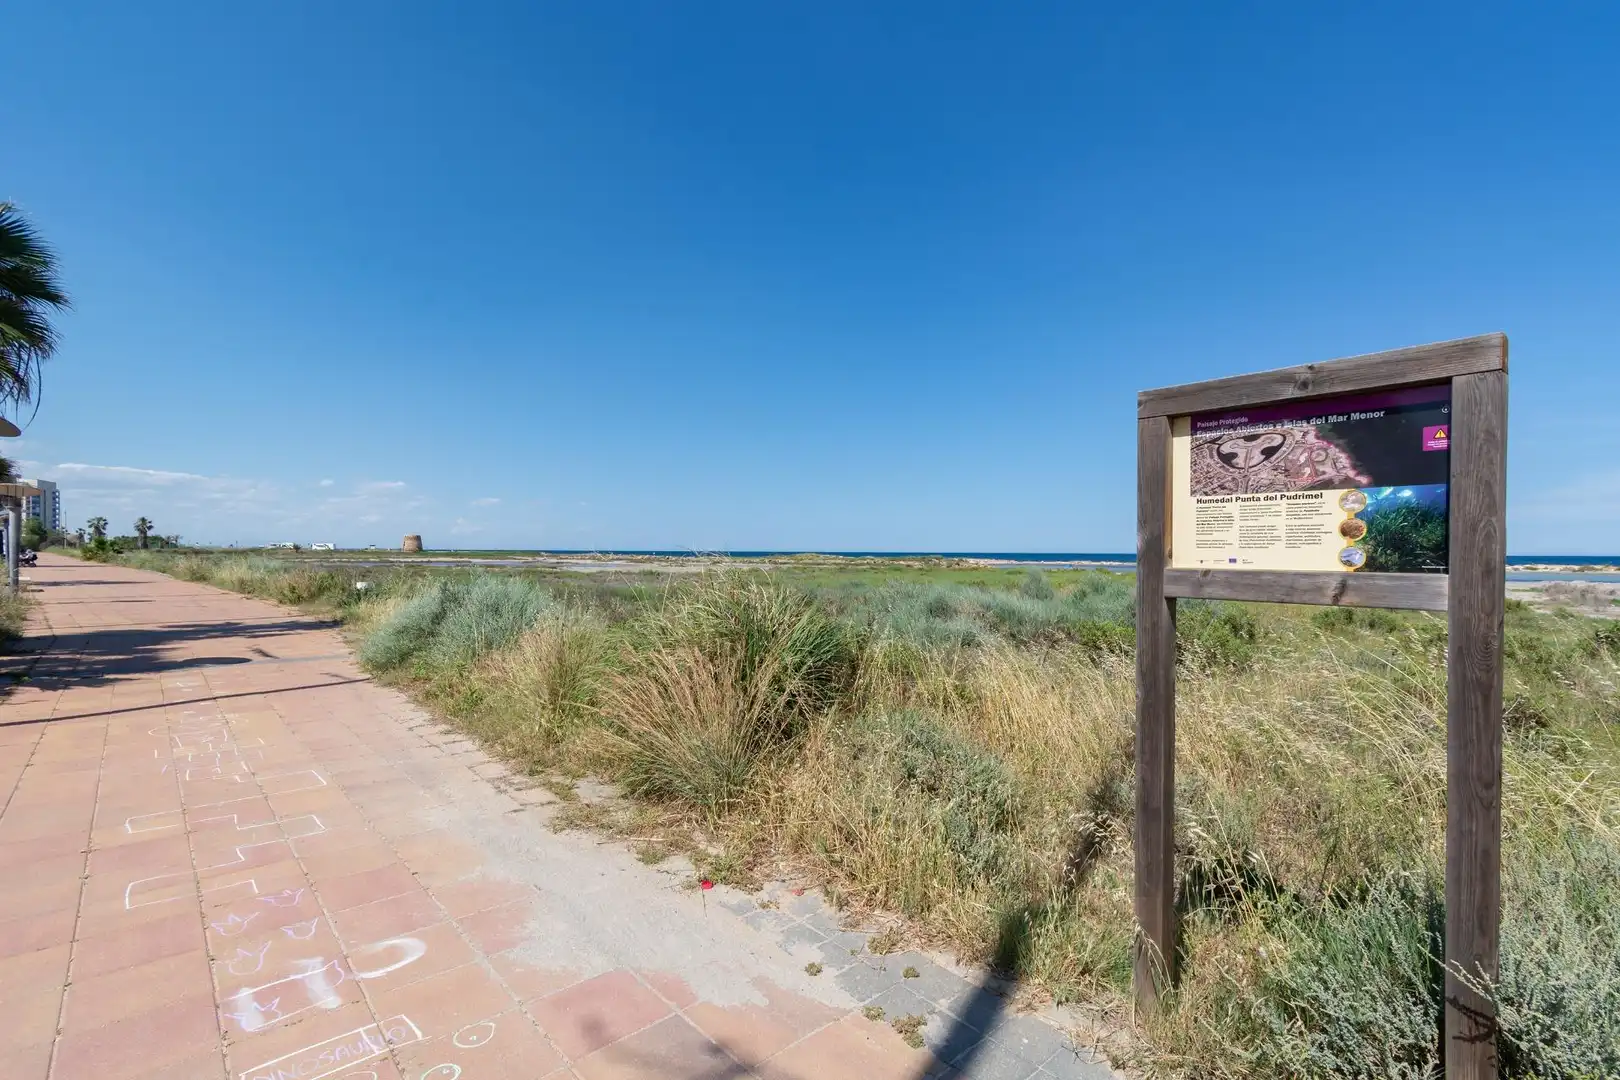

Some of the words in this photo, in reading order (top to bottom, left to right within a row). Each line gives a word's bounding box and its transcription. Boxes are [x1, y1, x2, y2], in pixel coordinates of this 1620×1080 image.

[1196, 428, 1234, 438] Espacios
[1236, 424, 1274, 433] Abiertos
[1283, 419, 1307, 428] Islas
[1310, 417, 1326, 425] del
[1328, 414, 1349, 423] Mar
[1350, 410, 1386, 421] Menor
[1219, 416, 1249, 426] Protegido
[1196, 496, 1233, 505] Humedal
[1235, 494, 1262, 503] Punta
[1263, 494, 1278, 502] del
[1280, 492, 1323, 501] Pudrimel
